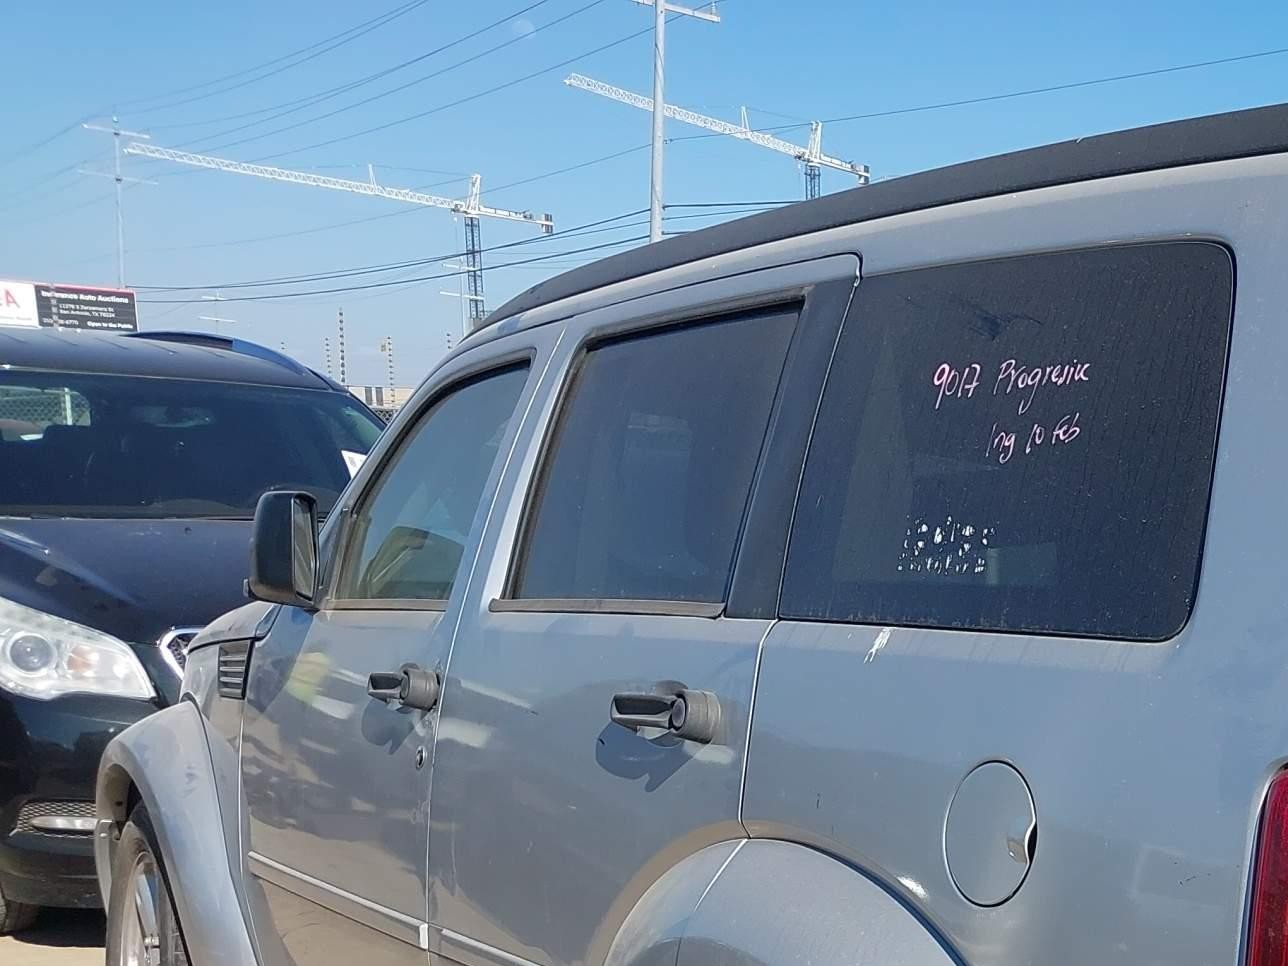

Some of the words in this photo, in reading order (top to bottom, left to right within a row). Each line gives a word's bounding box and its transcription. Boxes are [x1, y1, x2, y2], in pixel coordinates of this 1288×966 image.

[79, 293, 97, 302] Auto
[97, 294, 129, 304] Auctions
[87, 320, 102, 328] Open
